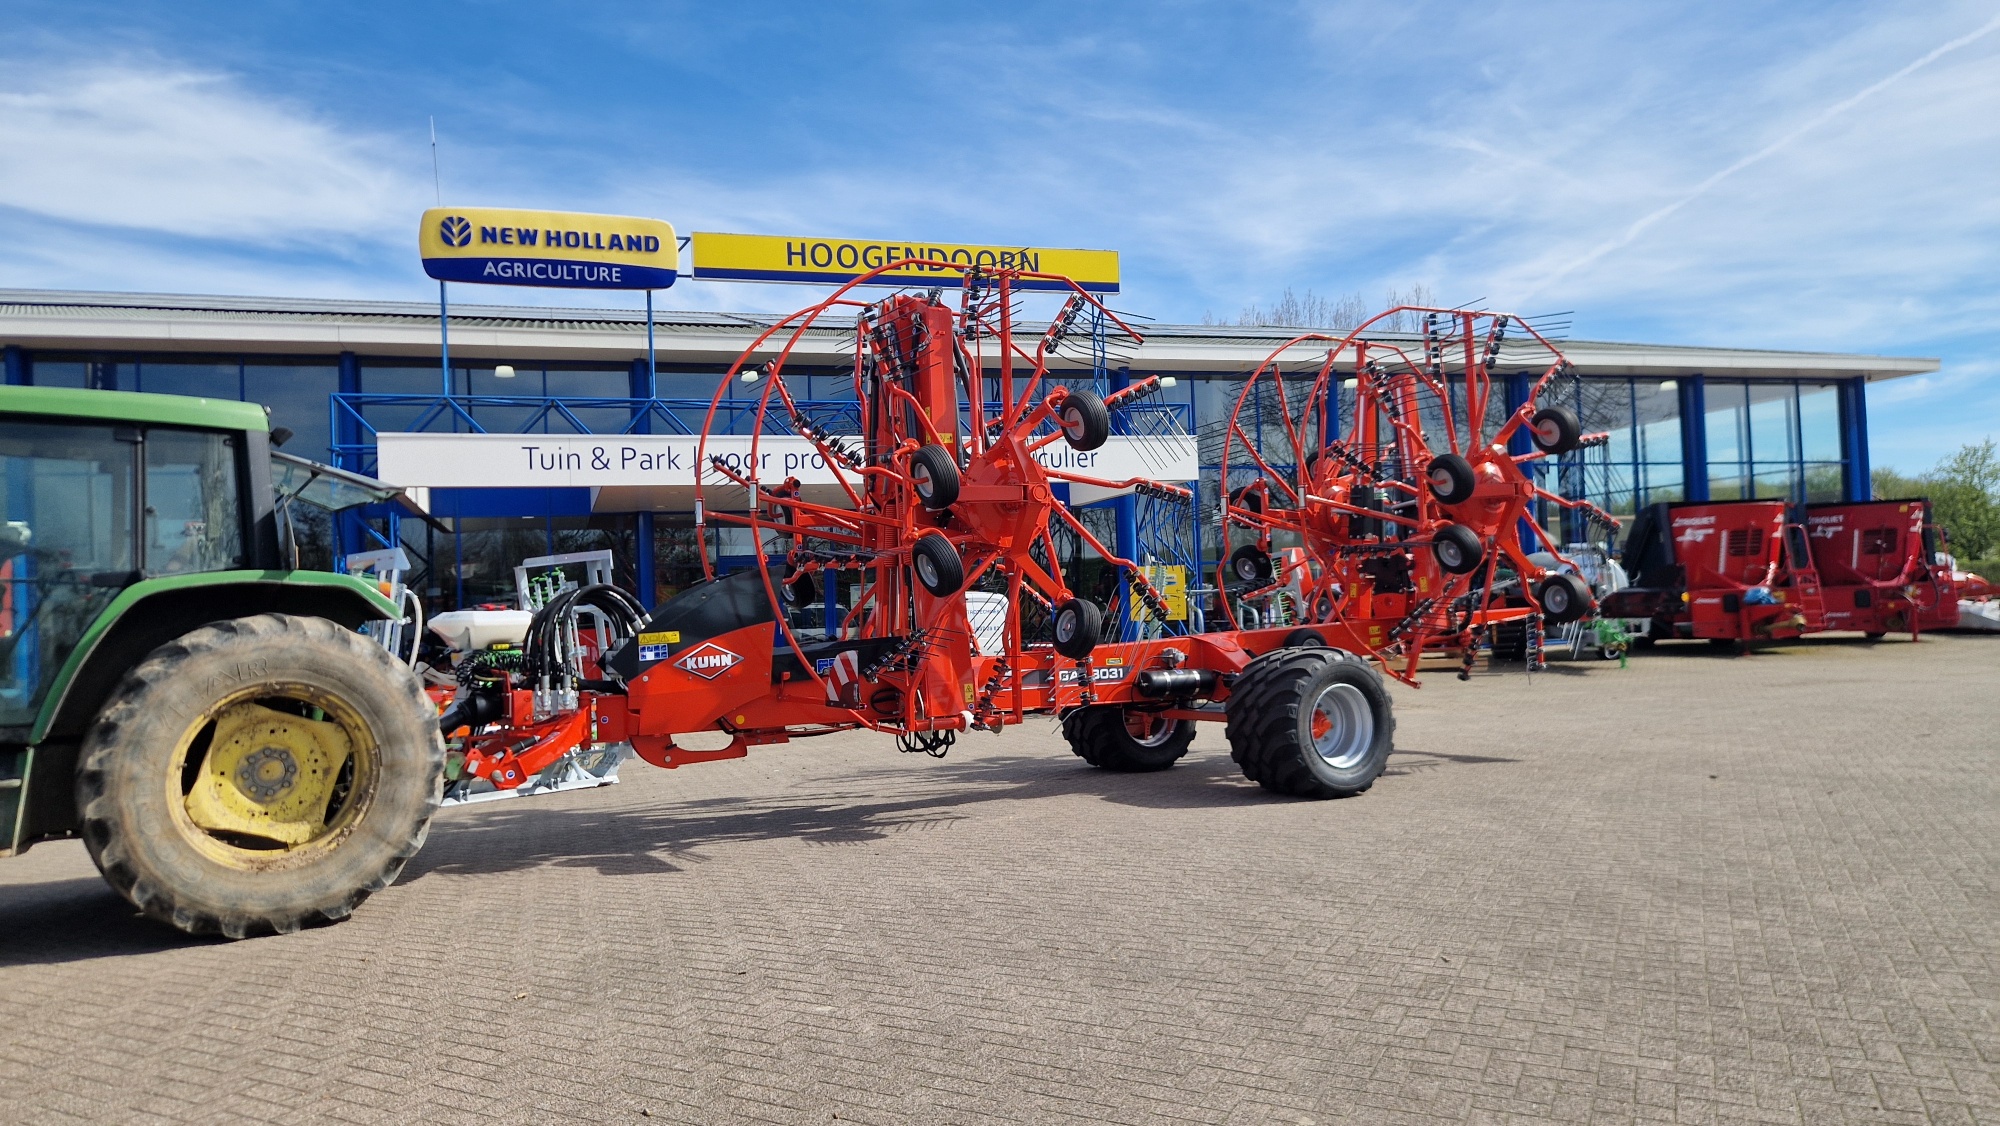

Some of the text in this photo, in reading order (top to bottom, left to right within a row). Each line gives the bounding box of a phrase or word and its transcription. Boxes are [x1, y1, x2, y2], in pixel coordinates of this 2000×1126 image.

[481, 226, 661, 253] NEW HOLLAND
[786, 241, 1039, 273] HOOGENDOORN
[482, 260, 622, 283] AGRICULTURE
[522, 446, 581, 471] Tuin
[590, 446, 610, 471] &
[621, 445, 681, 471] Park
[686, 653, 732, 670] KUHN
